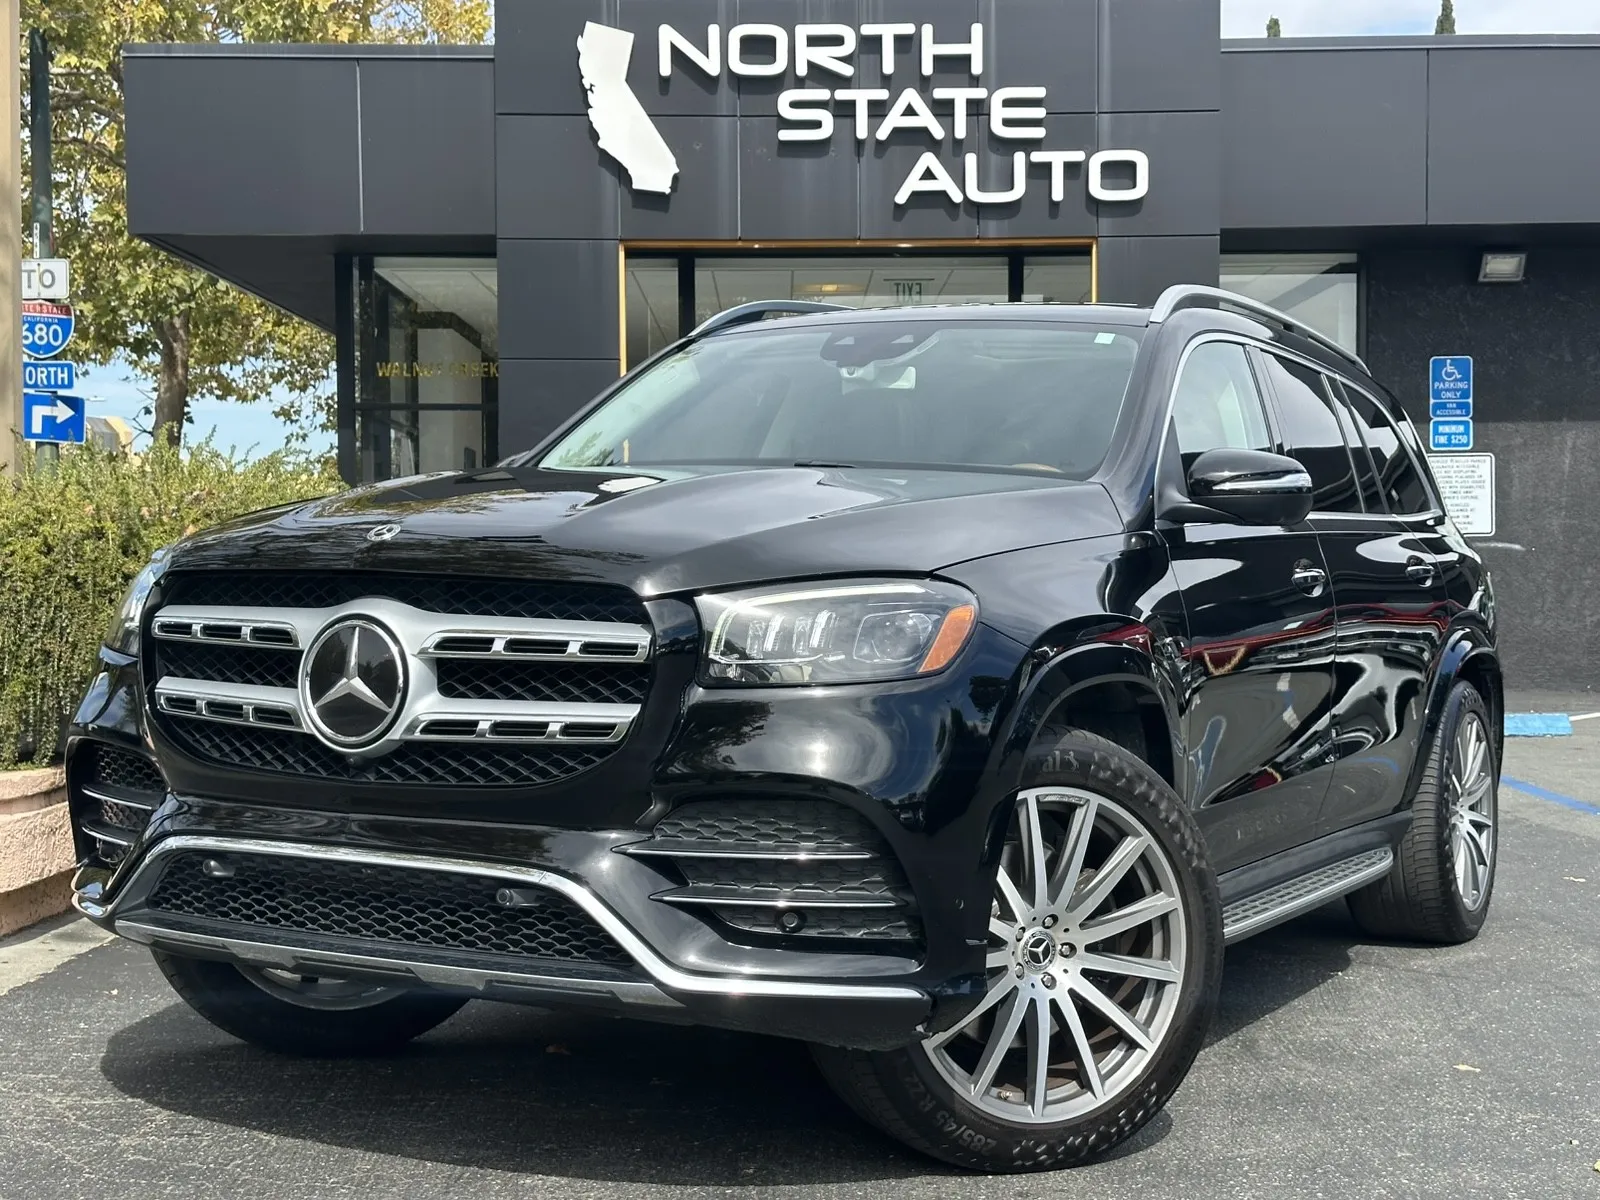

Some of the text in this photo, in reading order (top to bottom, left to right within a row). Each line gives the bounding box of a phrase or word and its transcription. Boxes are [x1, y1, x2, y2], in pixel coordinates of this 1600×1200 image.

[657, 22, 983, 78] NORTH
[777, 86, 1047, 142] STATE
[893, 148, 1150, 205] AUTO
[22, 268, 56, 289] TO
[22, 304, 67, 314] TERSTATE
[23, 316, 58, 324] CALIFORNIA
[22, 324, 63, 346] 680
[25, 366, 68, 386] ORTH
[1434, 381, 1468, 389] PARKING
[1440, 391, 1461, 399] ONLY
[1434, 435, 1468, 444] FINE $250
